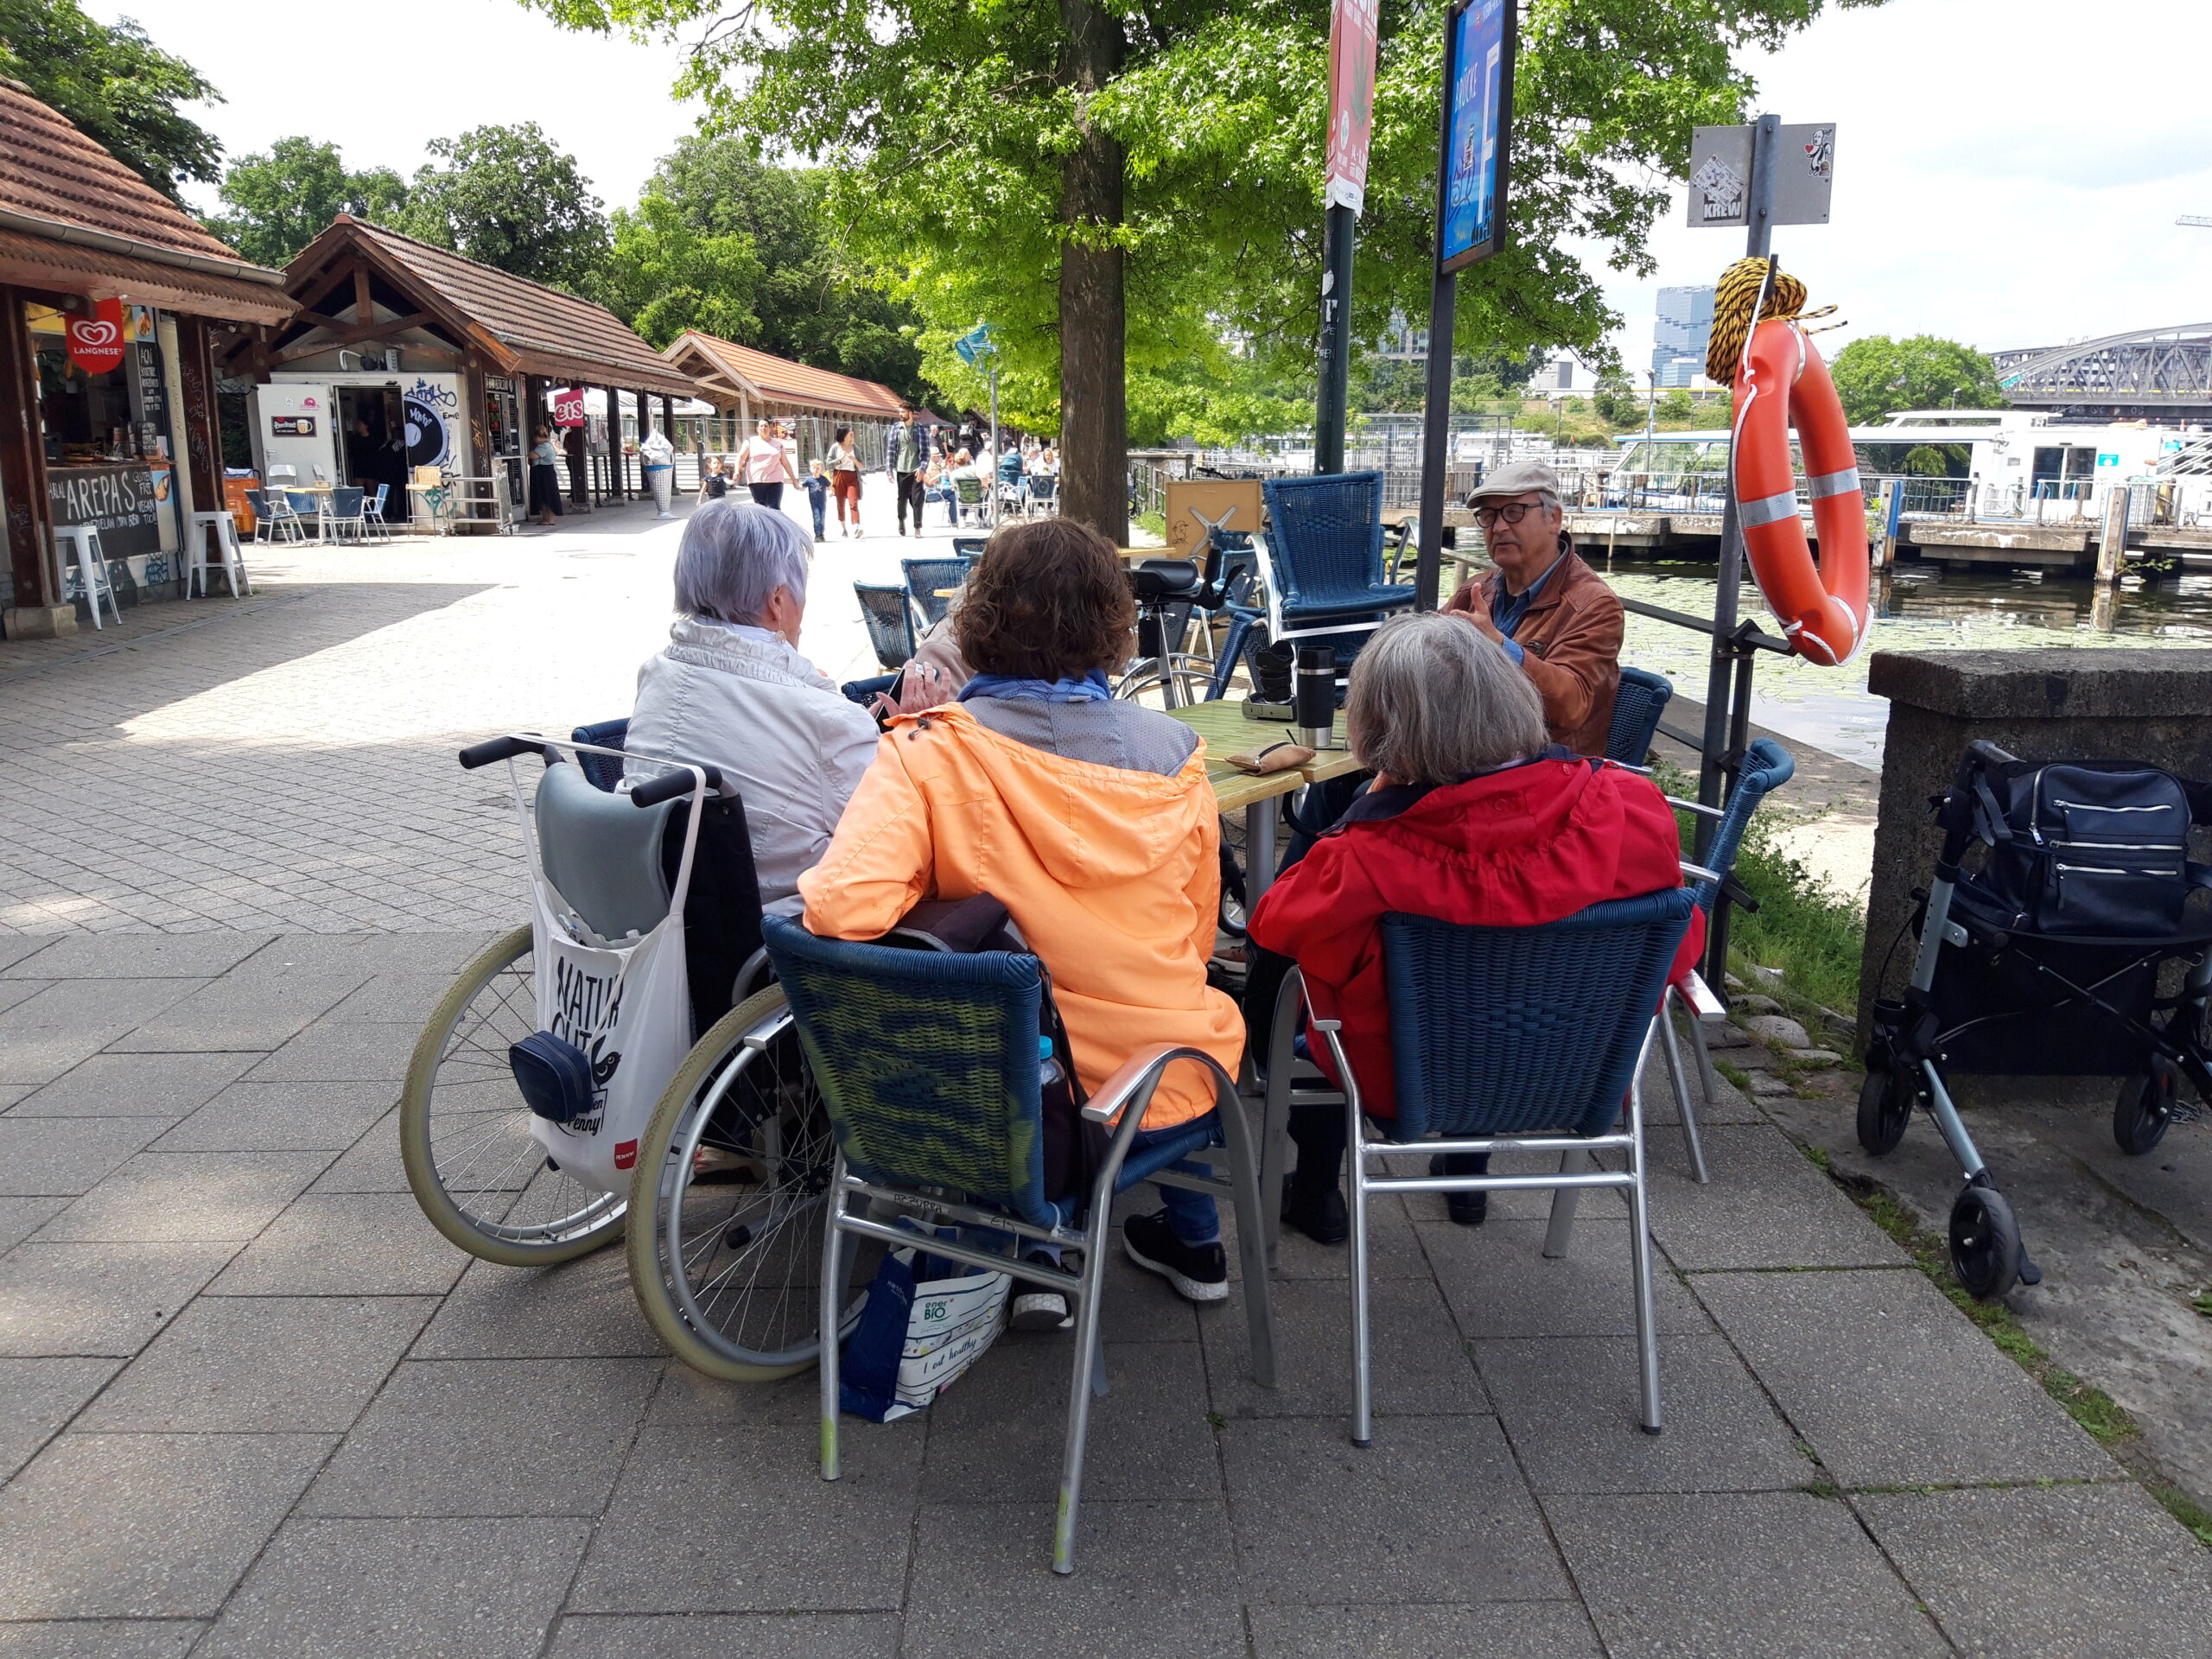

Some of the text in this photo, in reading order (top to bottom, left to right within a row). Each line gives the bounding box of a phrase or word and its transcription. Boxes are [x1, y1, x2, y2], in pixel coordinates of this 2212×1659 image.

[1704, 201, 1741, 218] KREW
[73, 346, 119, 355] LANGNESE
[67, 471, 136, 520] AREPAS
[556, 956, 626, 1030] NATUR
[925, 1300, 948, 1309] ener
[932, 1354, 945, 1370] eat
[949, 1337, 976, 1360] healthy
